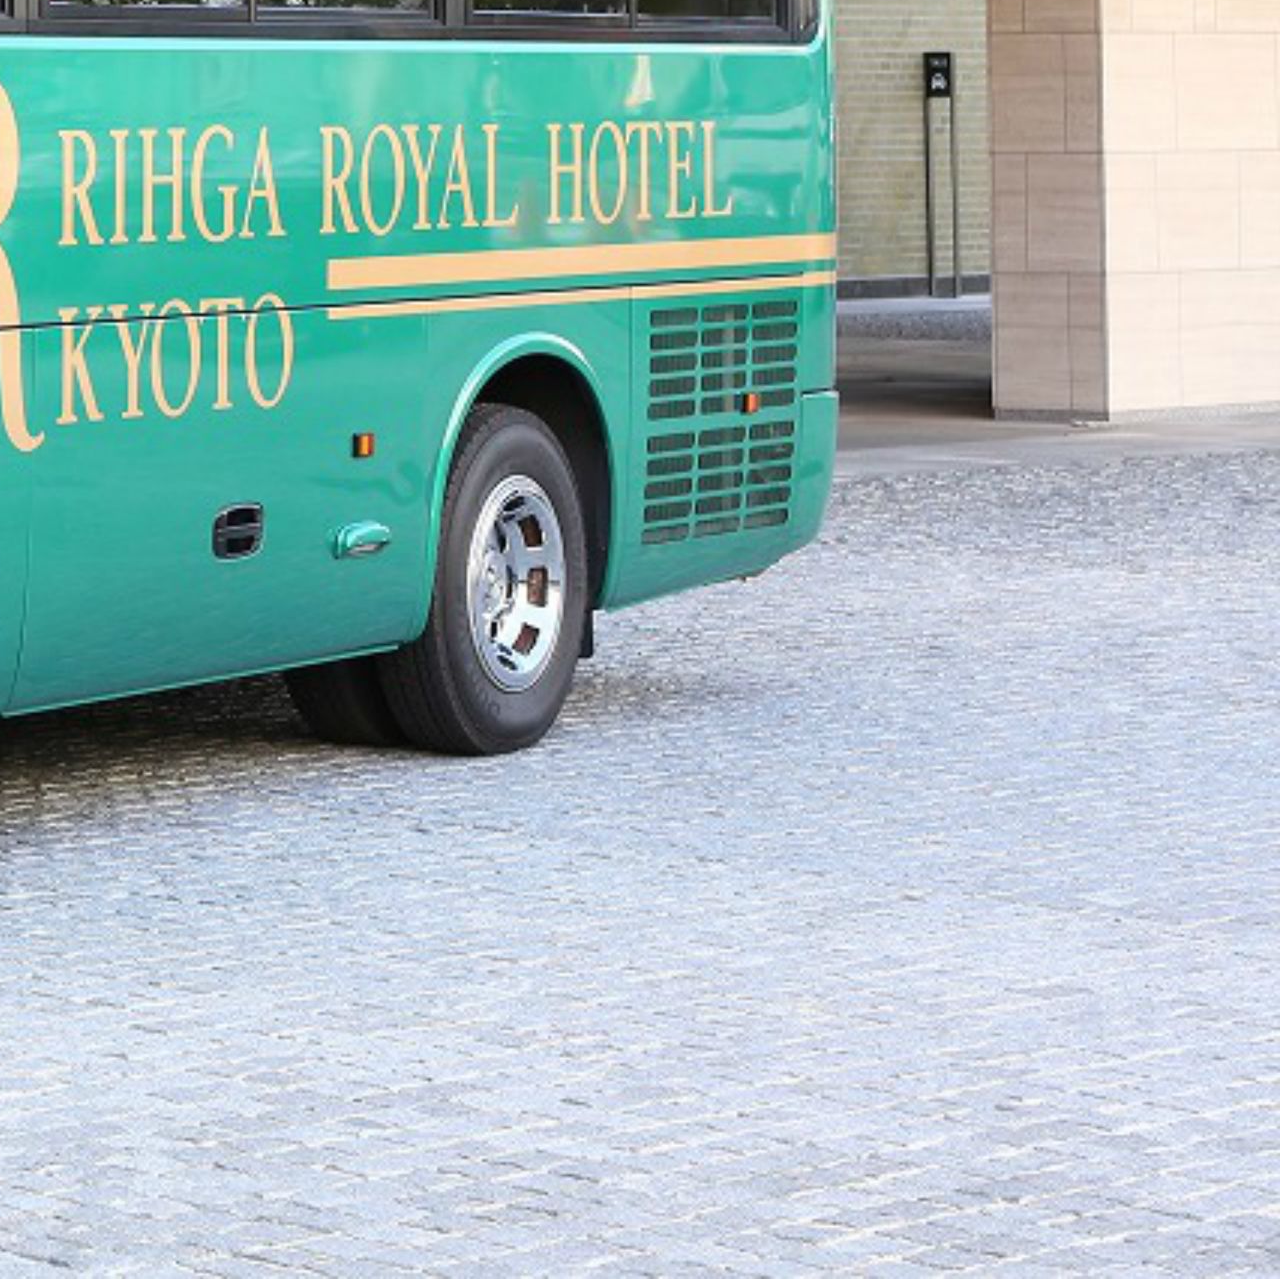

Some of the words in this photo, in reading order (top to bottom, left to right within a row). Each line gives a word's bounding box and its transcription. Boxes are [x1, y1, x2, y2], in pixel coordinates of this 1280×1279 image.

[58, 124, 287, 246] RIHGA
[319, 123, 519, 236] ROYAL
[546, 121, 734, 225] HOTEL
[56, 294, 295, 427] KYOTO
